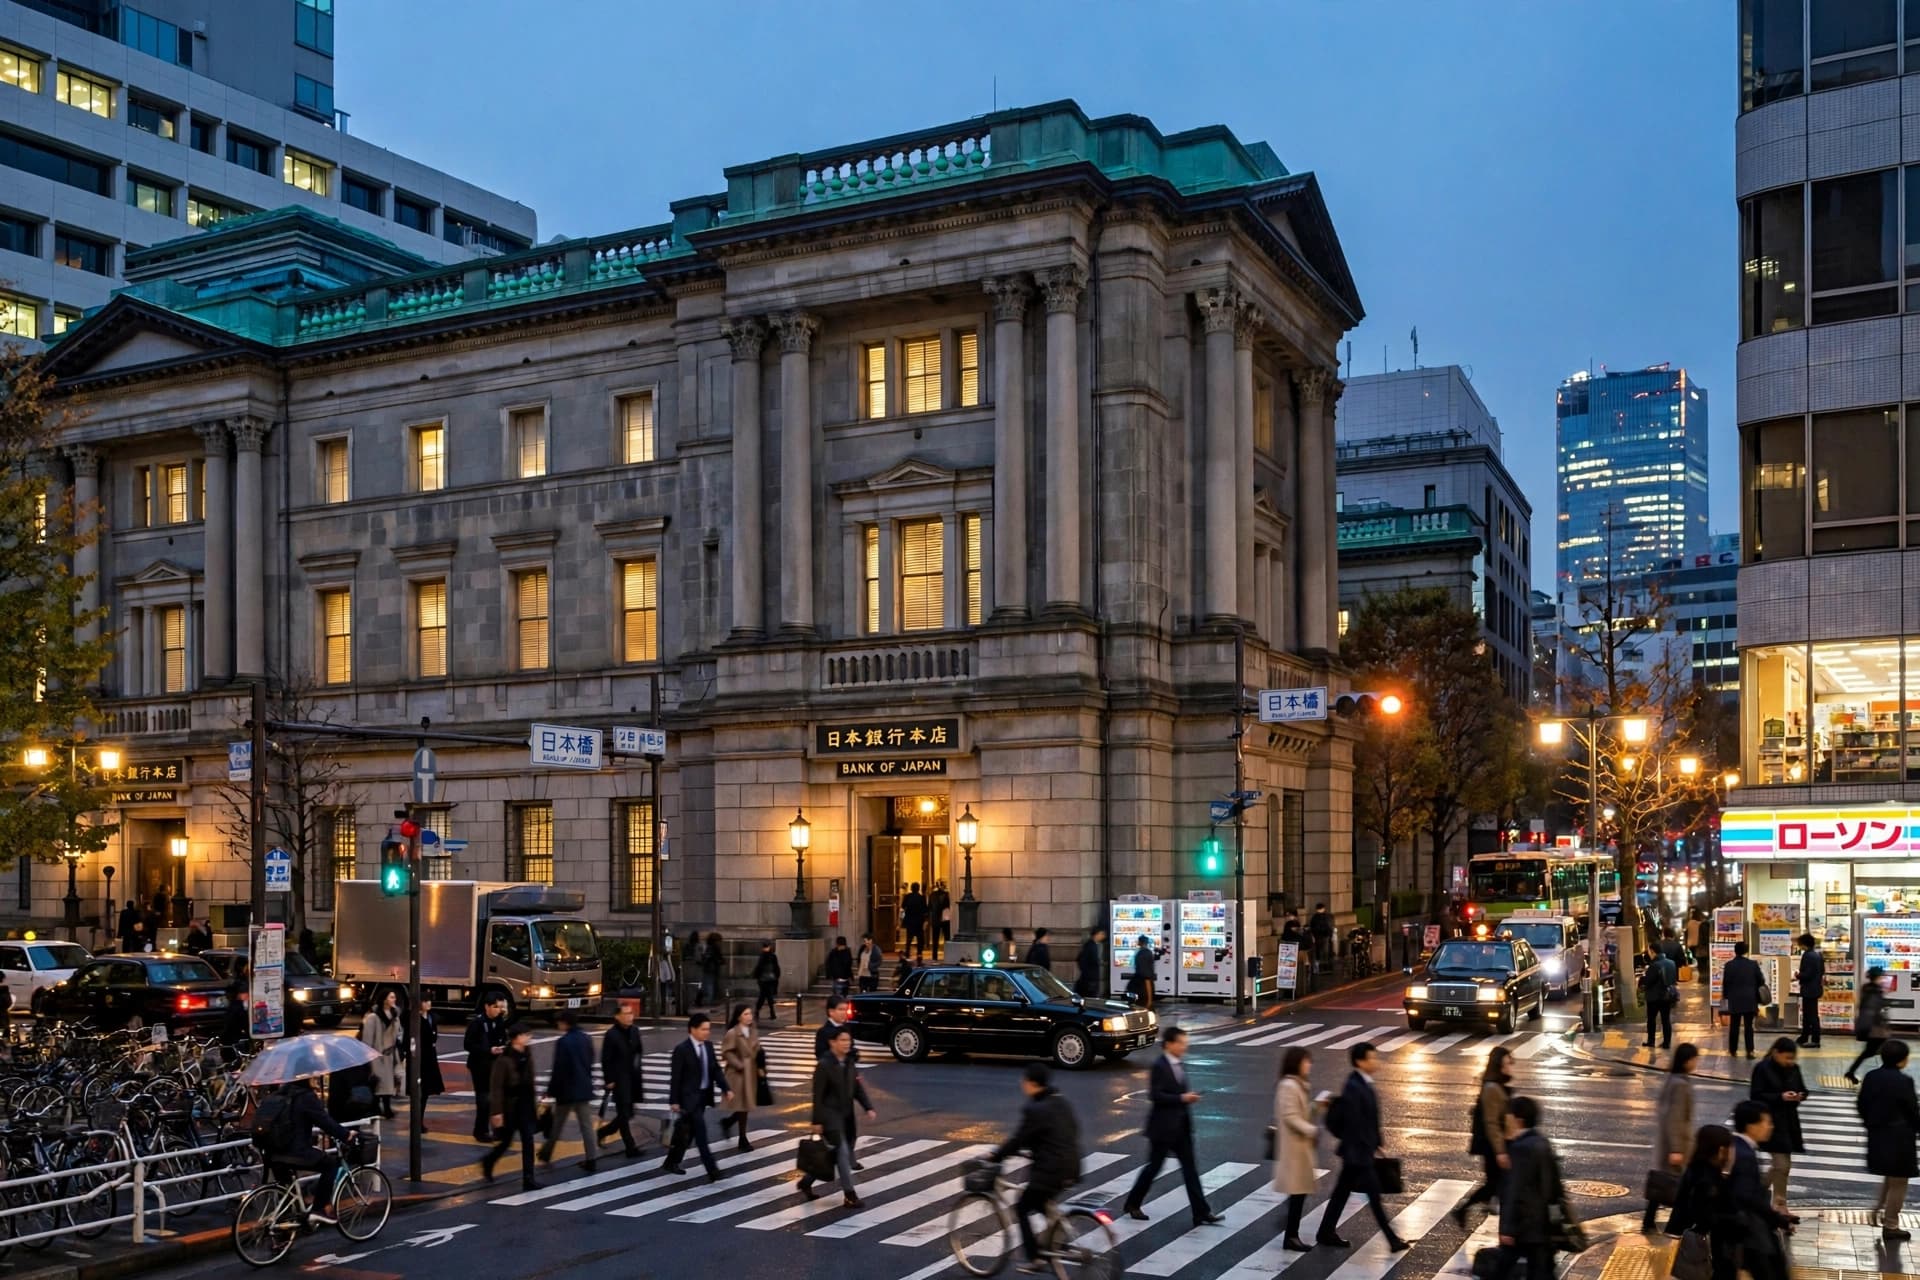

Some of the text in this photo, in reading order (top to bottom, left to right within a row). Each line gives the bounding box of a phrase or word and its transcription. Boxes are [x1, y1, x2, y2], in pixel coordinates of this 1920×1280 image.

[1269, 691, 1319, 711] 日本橋
[542, 732, 594, 756] 日本橋
[828, 725, 947, 748] 日本銀行本店
[842, 760, 941, 774] BANK OF JAPAN
[135, 792, 144, 801] OF
[147, 791, 172, 800] JAPAN
[1779, 821, 1902, 850] ローソン
